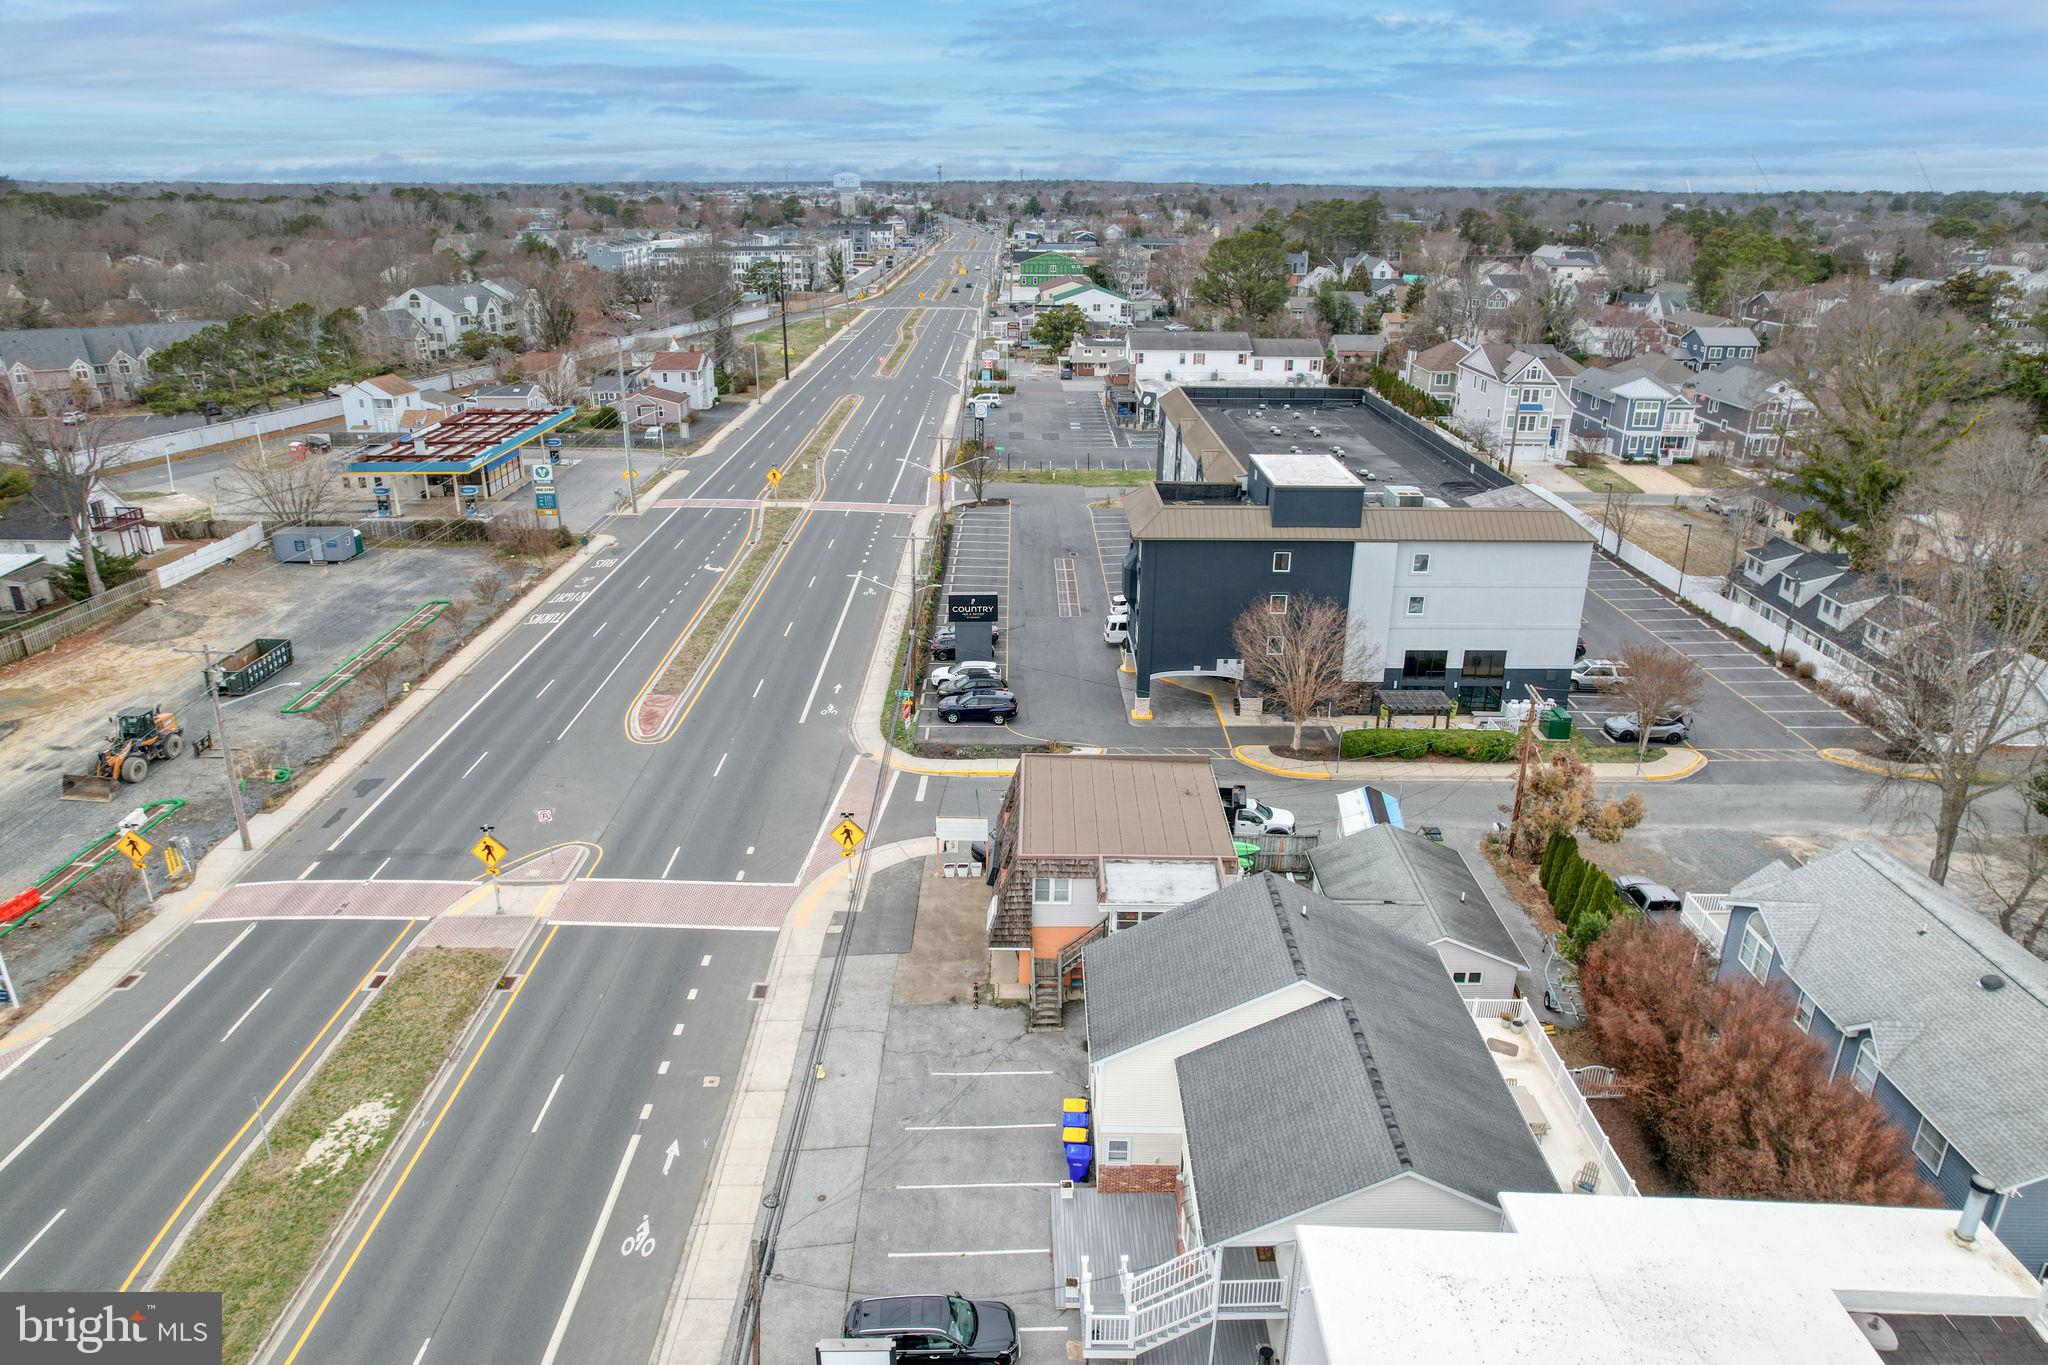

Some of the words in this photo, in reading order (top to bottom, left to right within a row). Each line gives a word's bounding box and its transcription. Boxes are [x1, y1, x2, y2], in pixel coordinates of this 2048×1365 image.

[591, 558, 619, 569] BUS
[547, 591, 589, 603] RIGHT
[524, 612, 566, 625] TURNS
